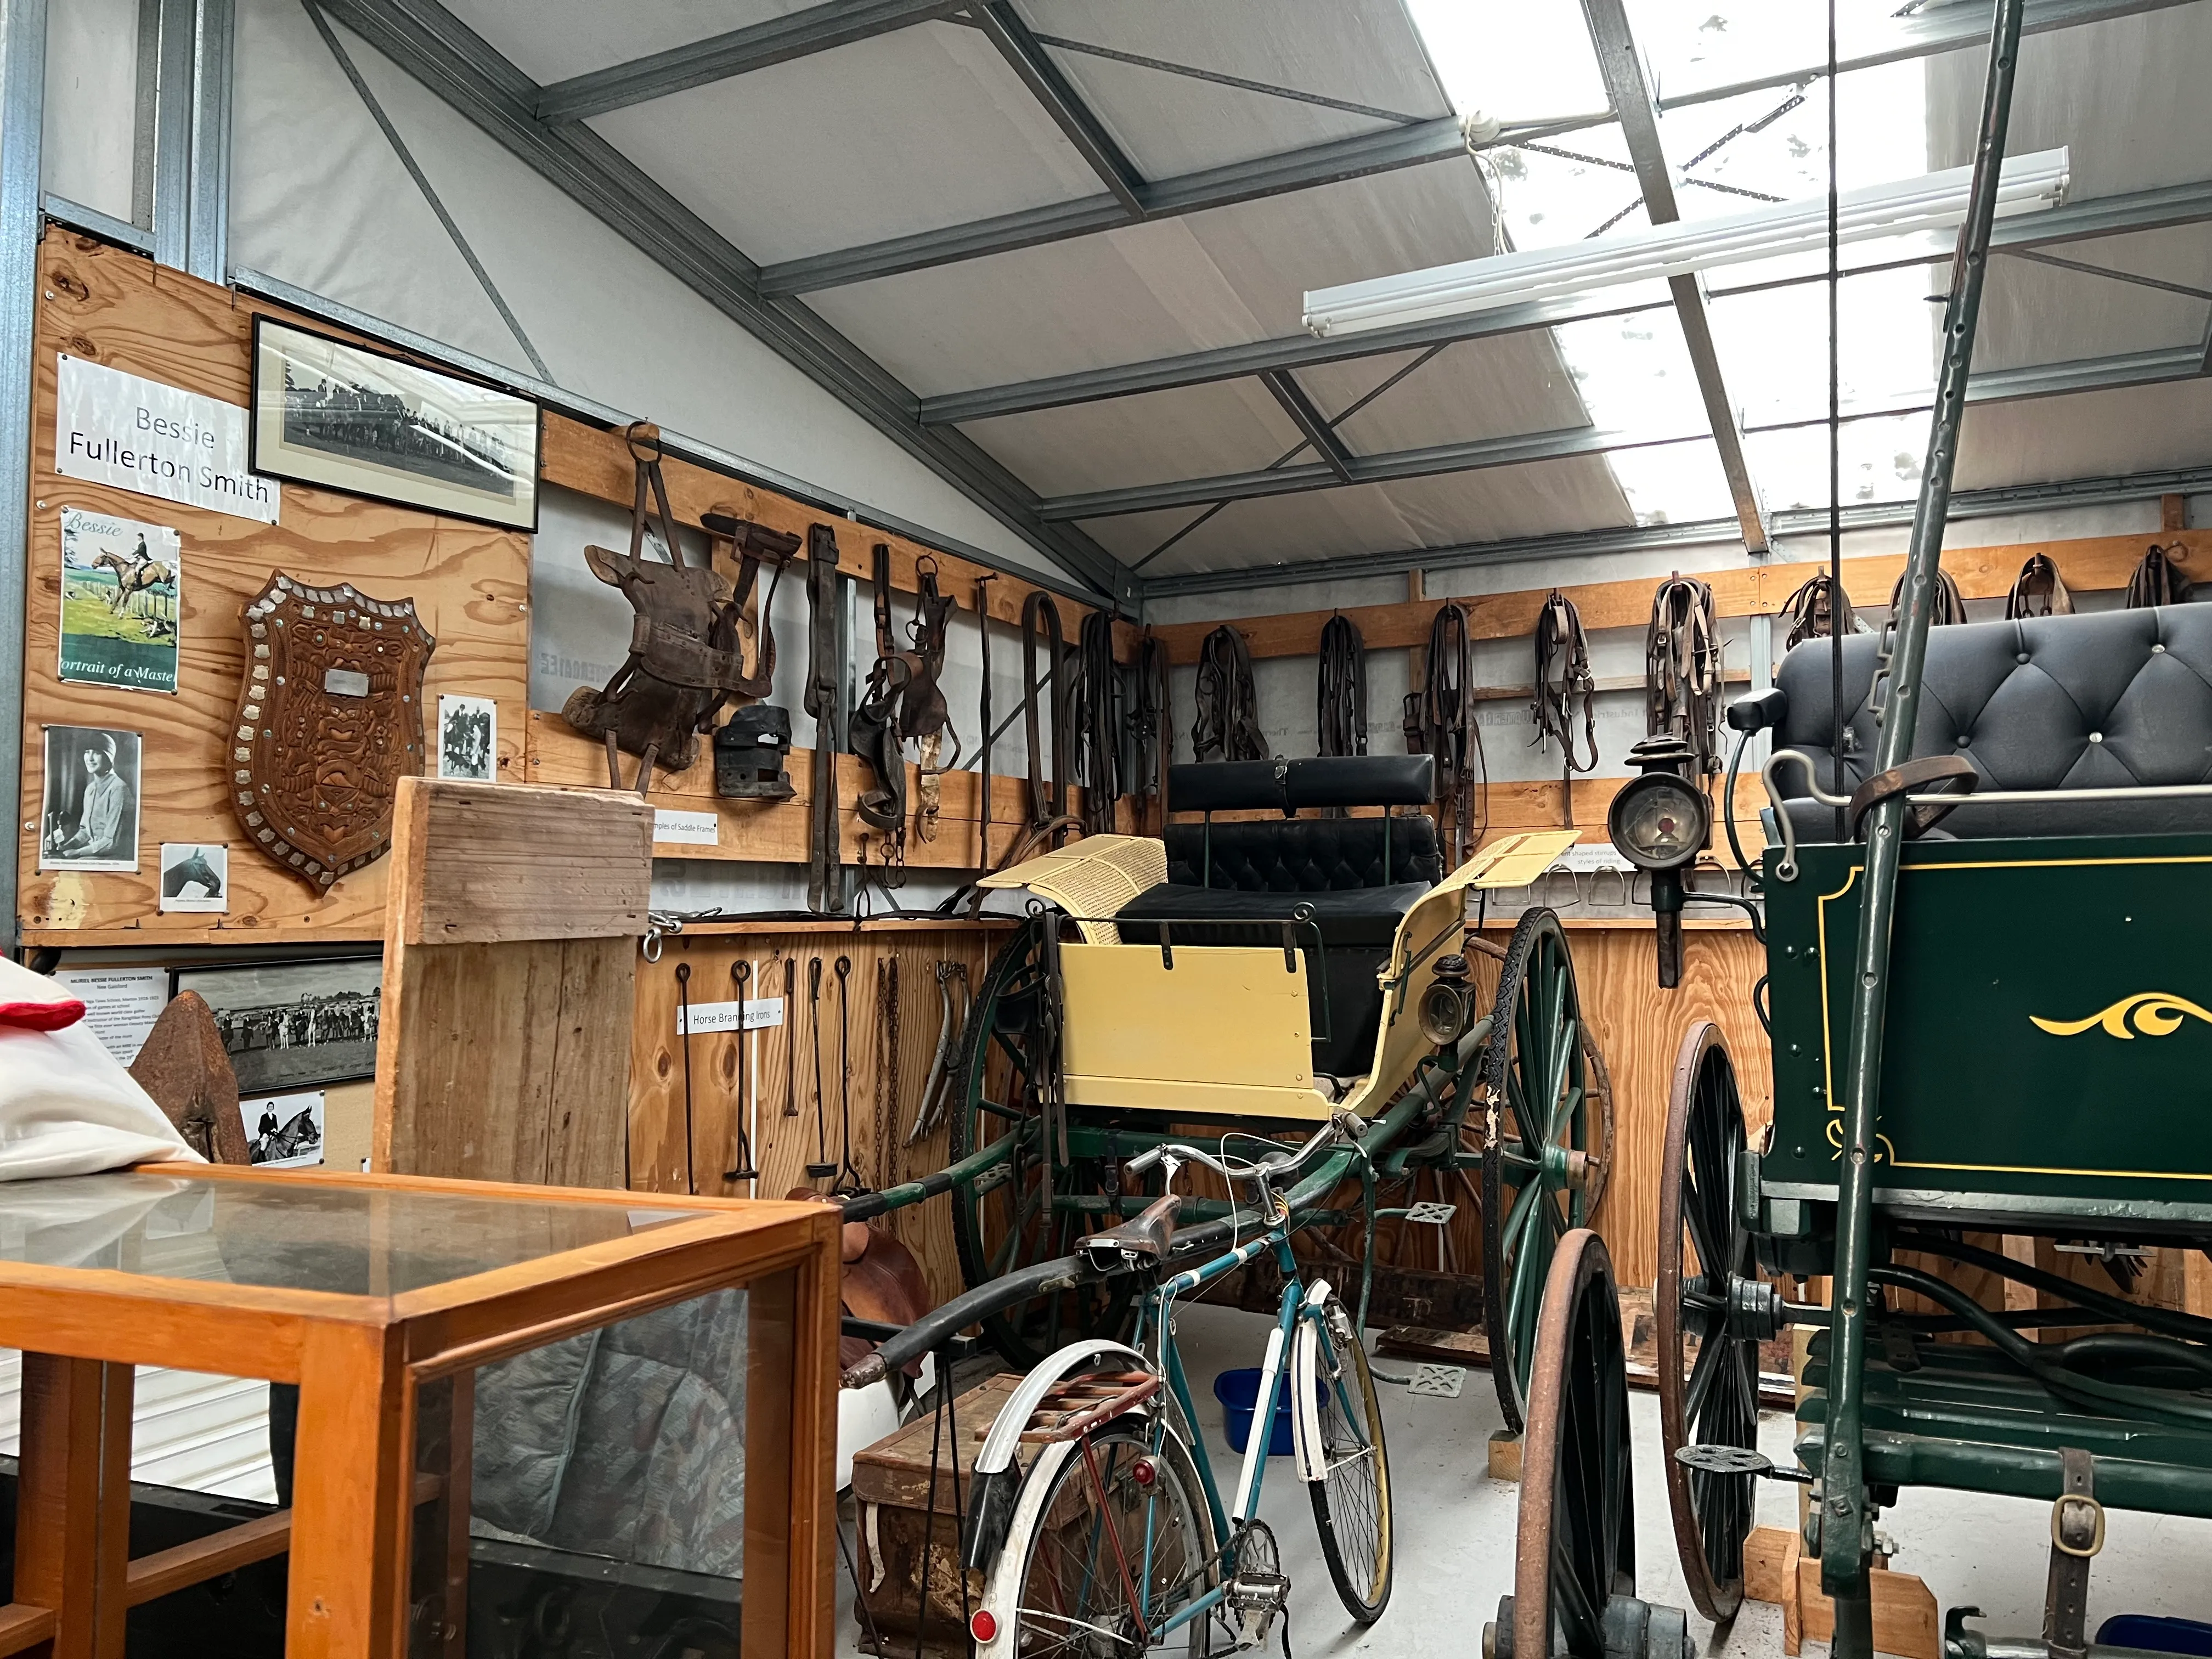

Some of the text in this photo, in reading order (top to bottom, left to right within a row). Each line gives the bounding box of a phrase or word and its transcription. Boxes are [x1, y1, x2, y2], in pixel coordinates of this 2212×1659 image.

[136, 407, 215, 449] Bessie
[70, 432, 268, 503] Fullerton Smith
[65, 512, 123, 537] Bessie
[109, 664, 123, 678] of
[125, 668, 132, 677] a
[654, 822, 669, 831] mples
[693, 1011, 770, 1024] Horse Braning Irons
